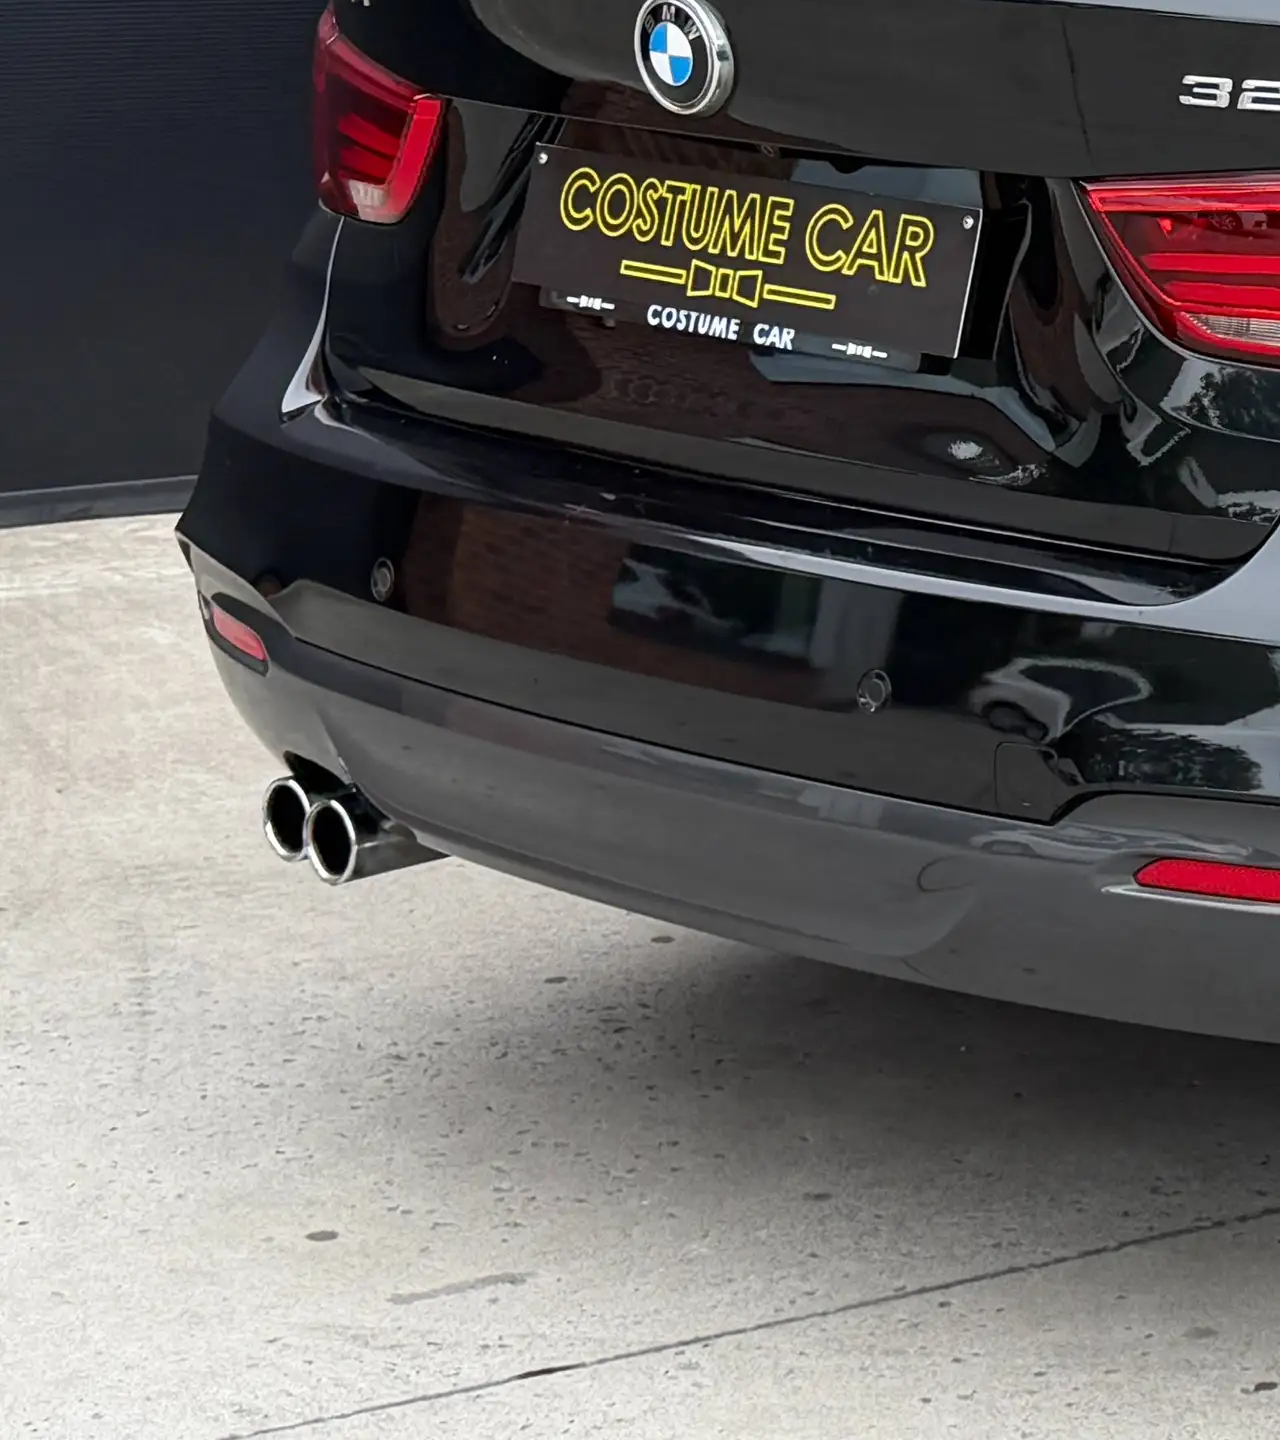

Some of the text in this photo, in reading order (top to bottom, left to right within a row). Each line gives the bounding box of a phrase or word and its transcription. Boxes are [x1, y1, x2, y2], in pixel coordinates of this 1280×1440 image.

[644, 4, 701, 40] BMW
[560, 167, 935, 288] COSTUME CAR
[646, 304, 796, 350] COSTUME CAR
